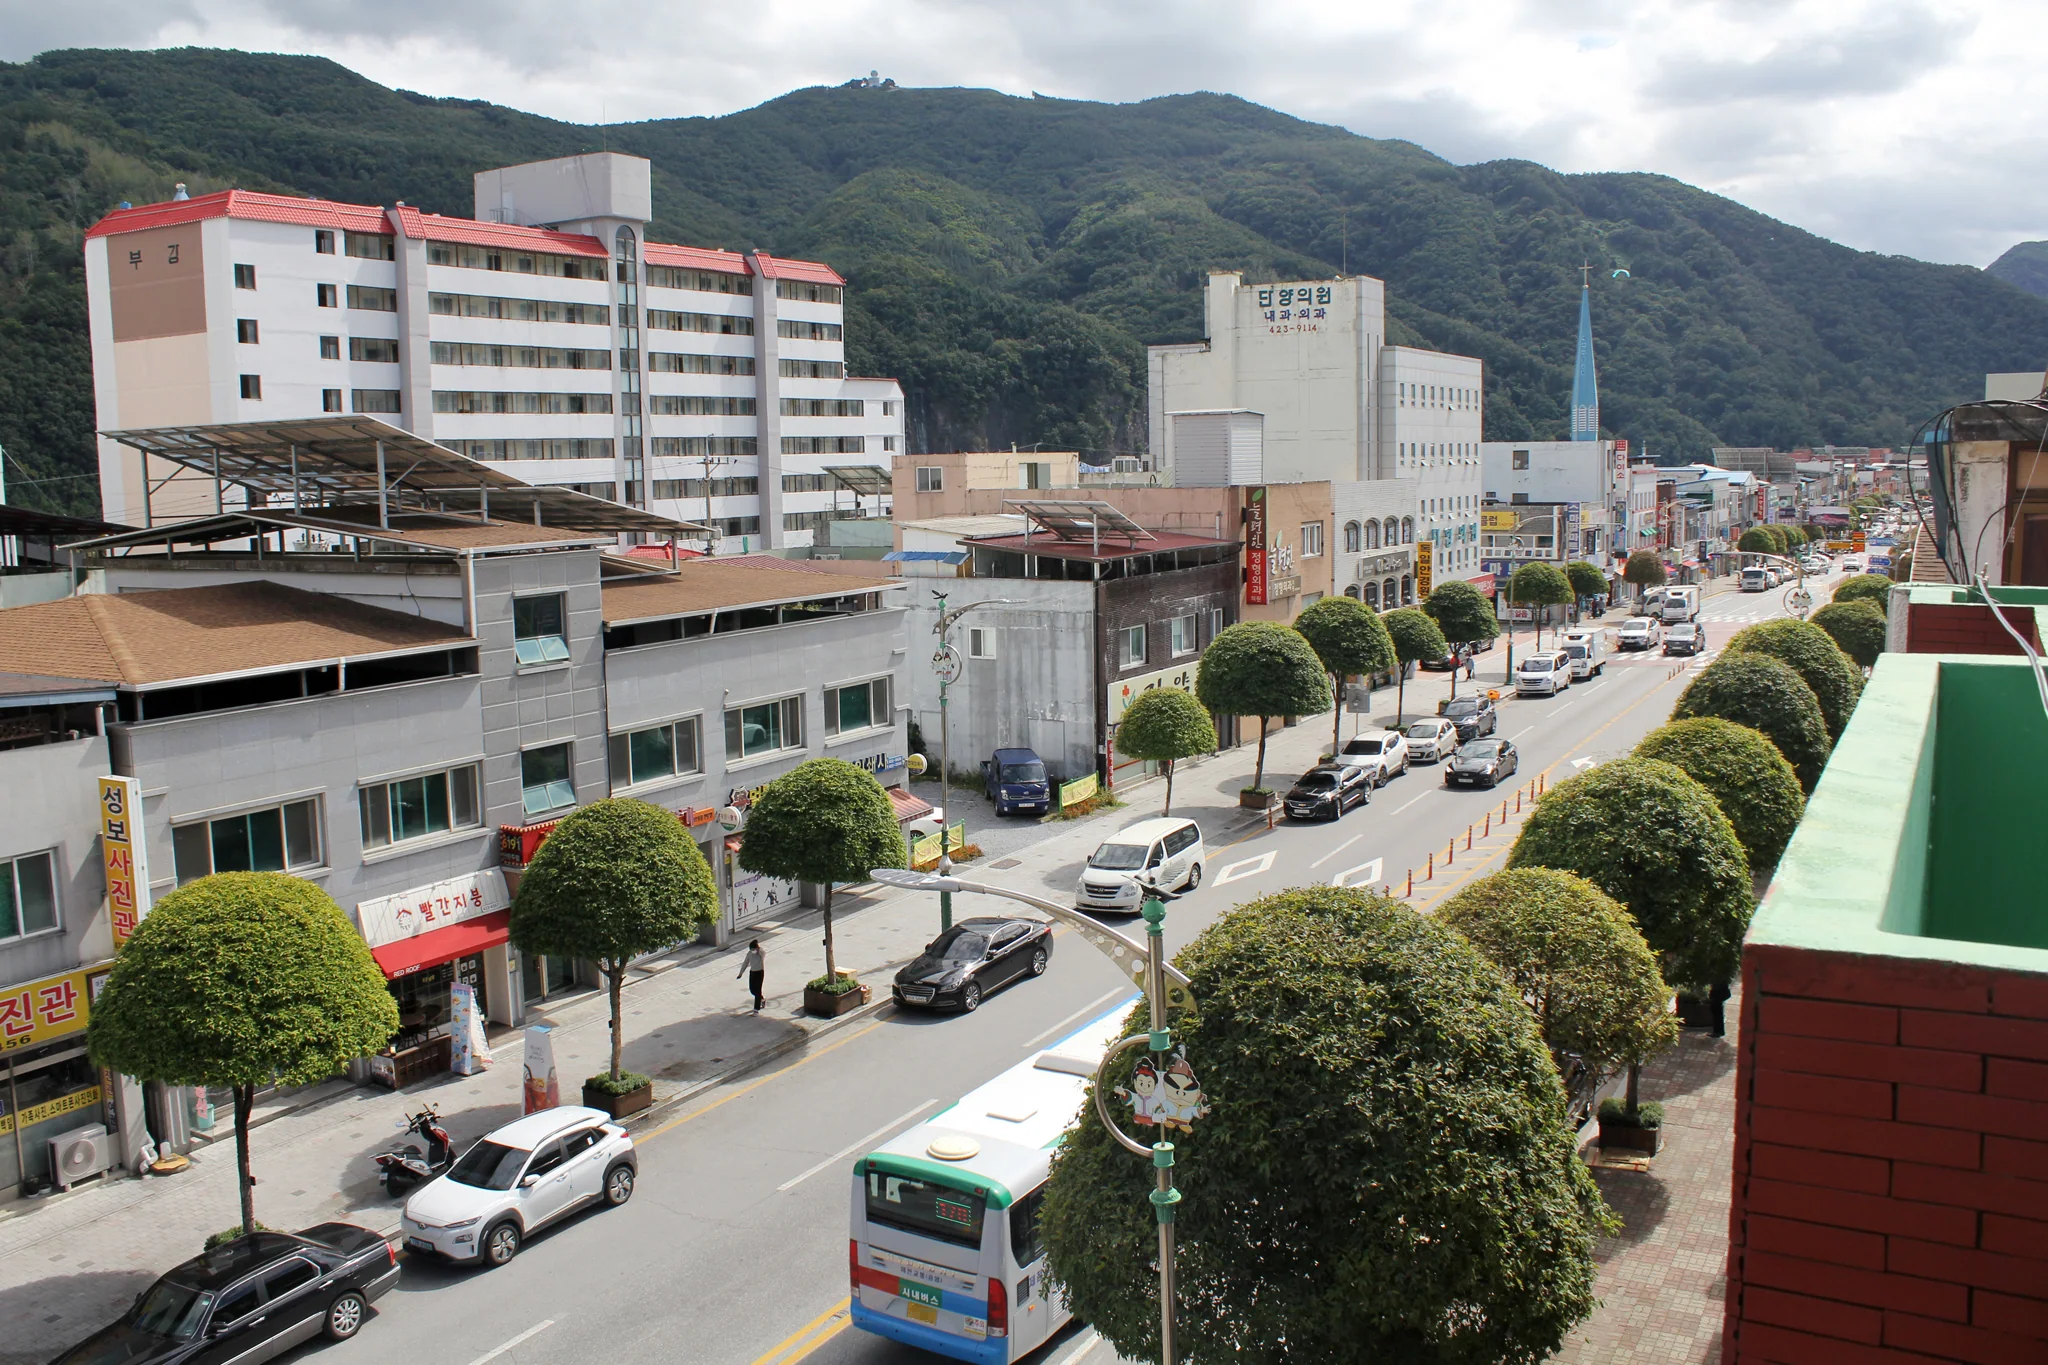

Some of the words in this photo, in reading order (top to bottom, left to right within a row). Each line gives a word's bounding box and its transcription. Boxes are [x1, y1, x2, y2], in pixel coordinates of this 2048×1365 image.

[1258, 286, 1331, 308] 단양의원
[1269, 324, 1317, 334] 423-9114
[1616, 454, 1626, 479] 다이소
[1252, 552, 1263, 595] 정형외과
[419, 887, 483, 923] 빨간지붕
[393, 970, 405, 978] RED
[405, 964, 421, 974] ROOF
[902, 1287, 939, 1307] 시내버스
